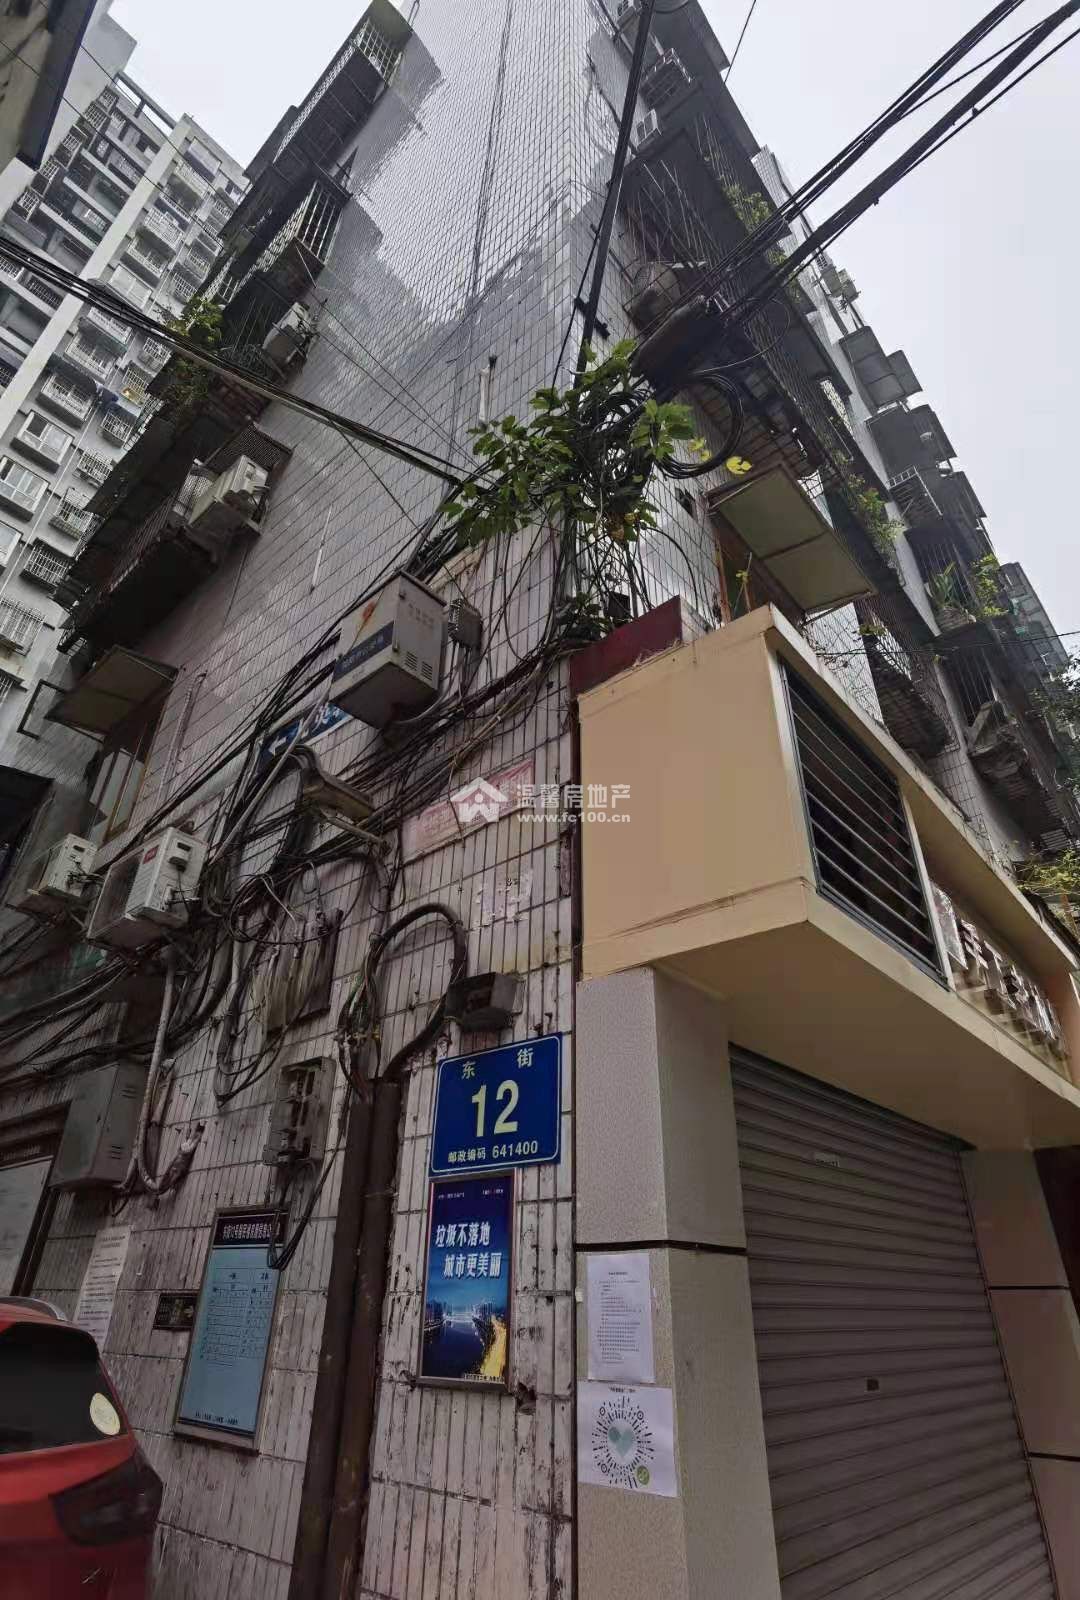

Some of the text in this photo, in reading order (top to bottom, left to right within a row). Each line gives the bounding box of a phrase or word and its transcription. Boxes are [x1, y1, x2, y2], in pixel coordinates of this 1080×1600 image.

[461, 1048, 534, 1079] 东街
[471, 1079, 519, 1138] 12
[447, 1140, 539, 1163] 邮政编码 641400
[435, 1220, 492, 1249] 垃圾不落地
[443, 1252, 503, 1279] 城市更美丽
